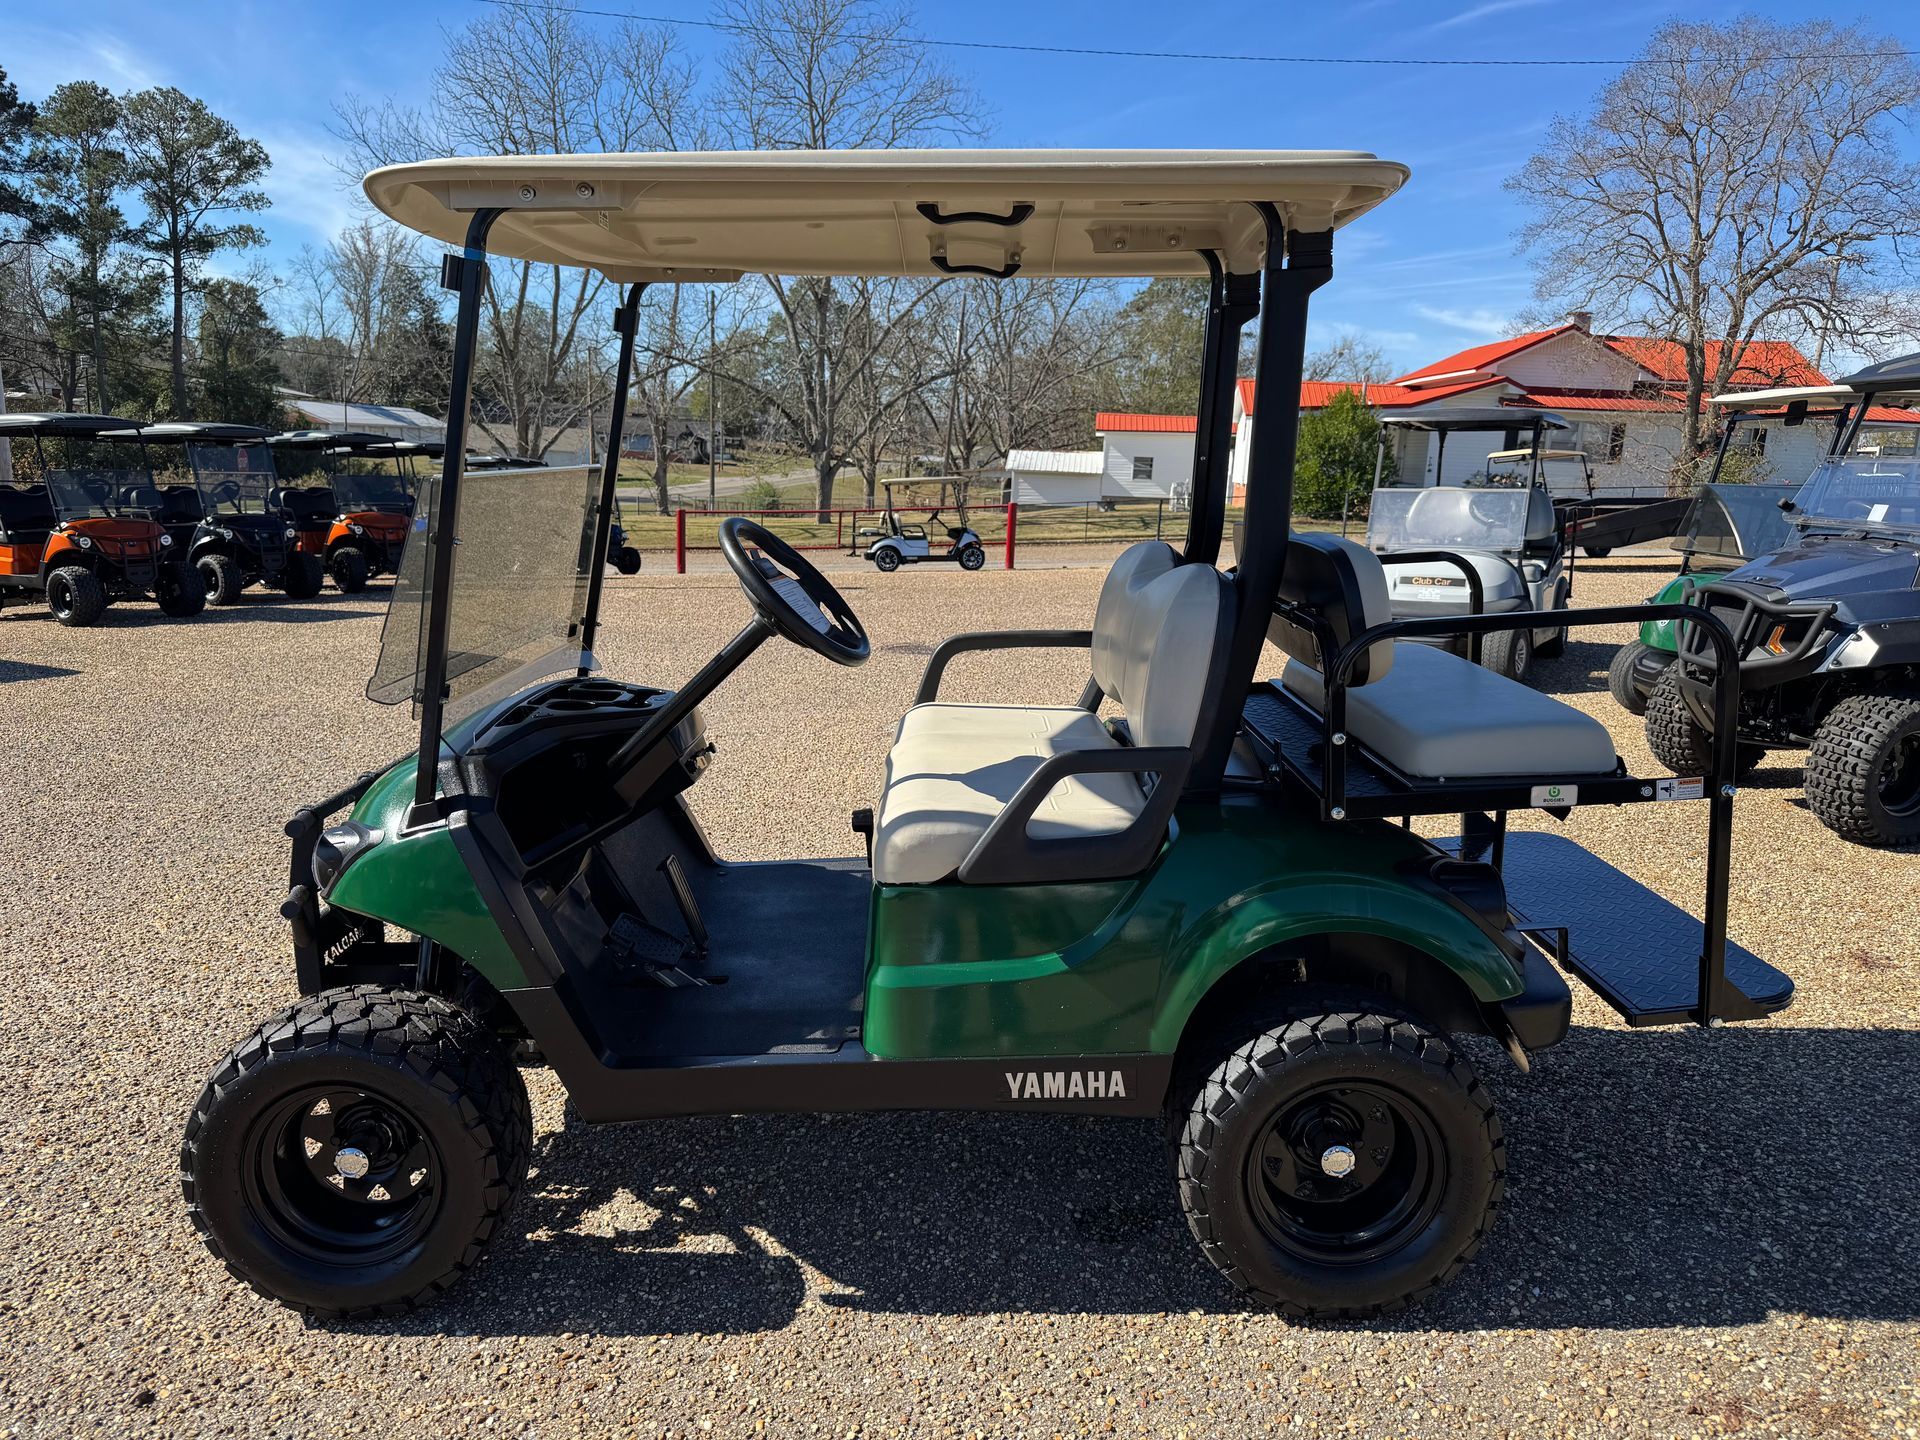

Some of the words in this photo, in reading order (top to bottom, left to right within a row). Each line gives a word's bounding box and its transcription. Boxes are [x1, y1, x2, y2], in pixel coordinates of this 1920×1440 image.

[1412, 577, 1432, 585] Club
[1434, 578, 1452, 586] Car
[1005, 1071, 1126, 1098] YAMAHA
